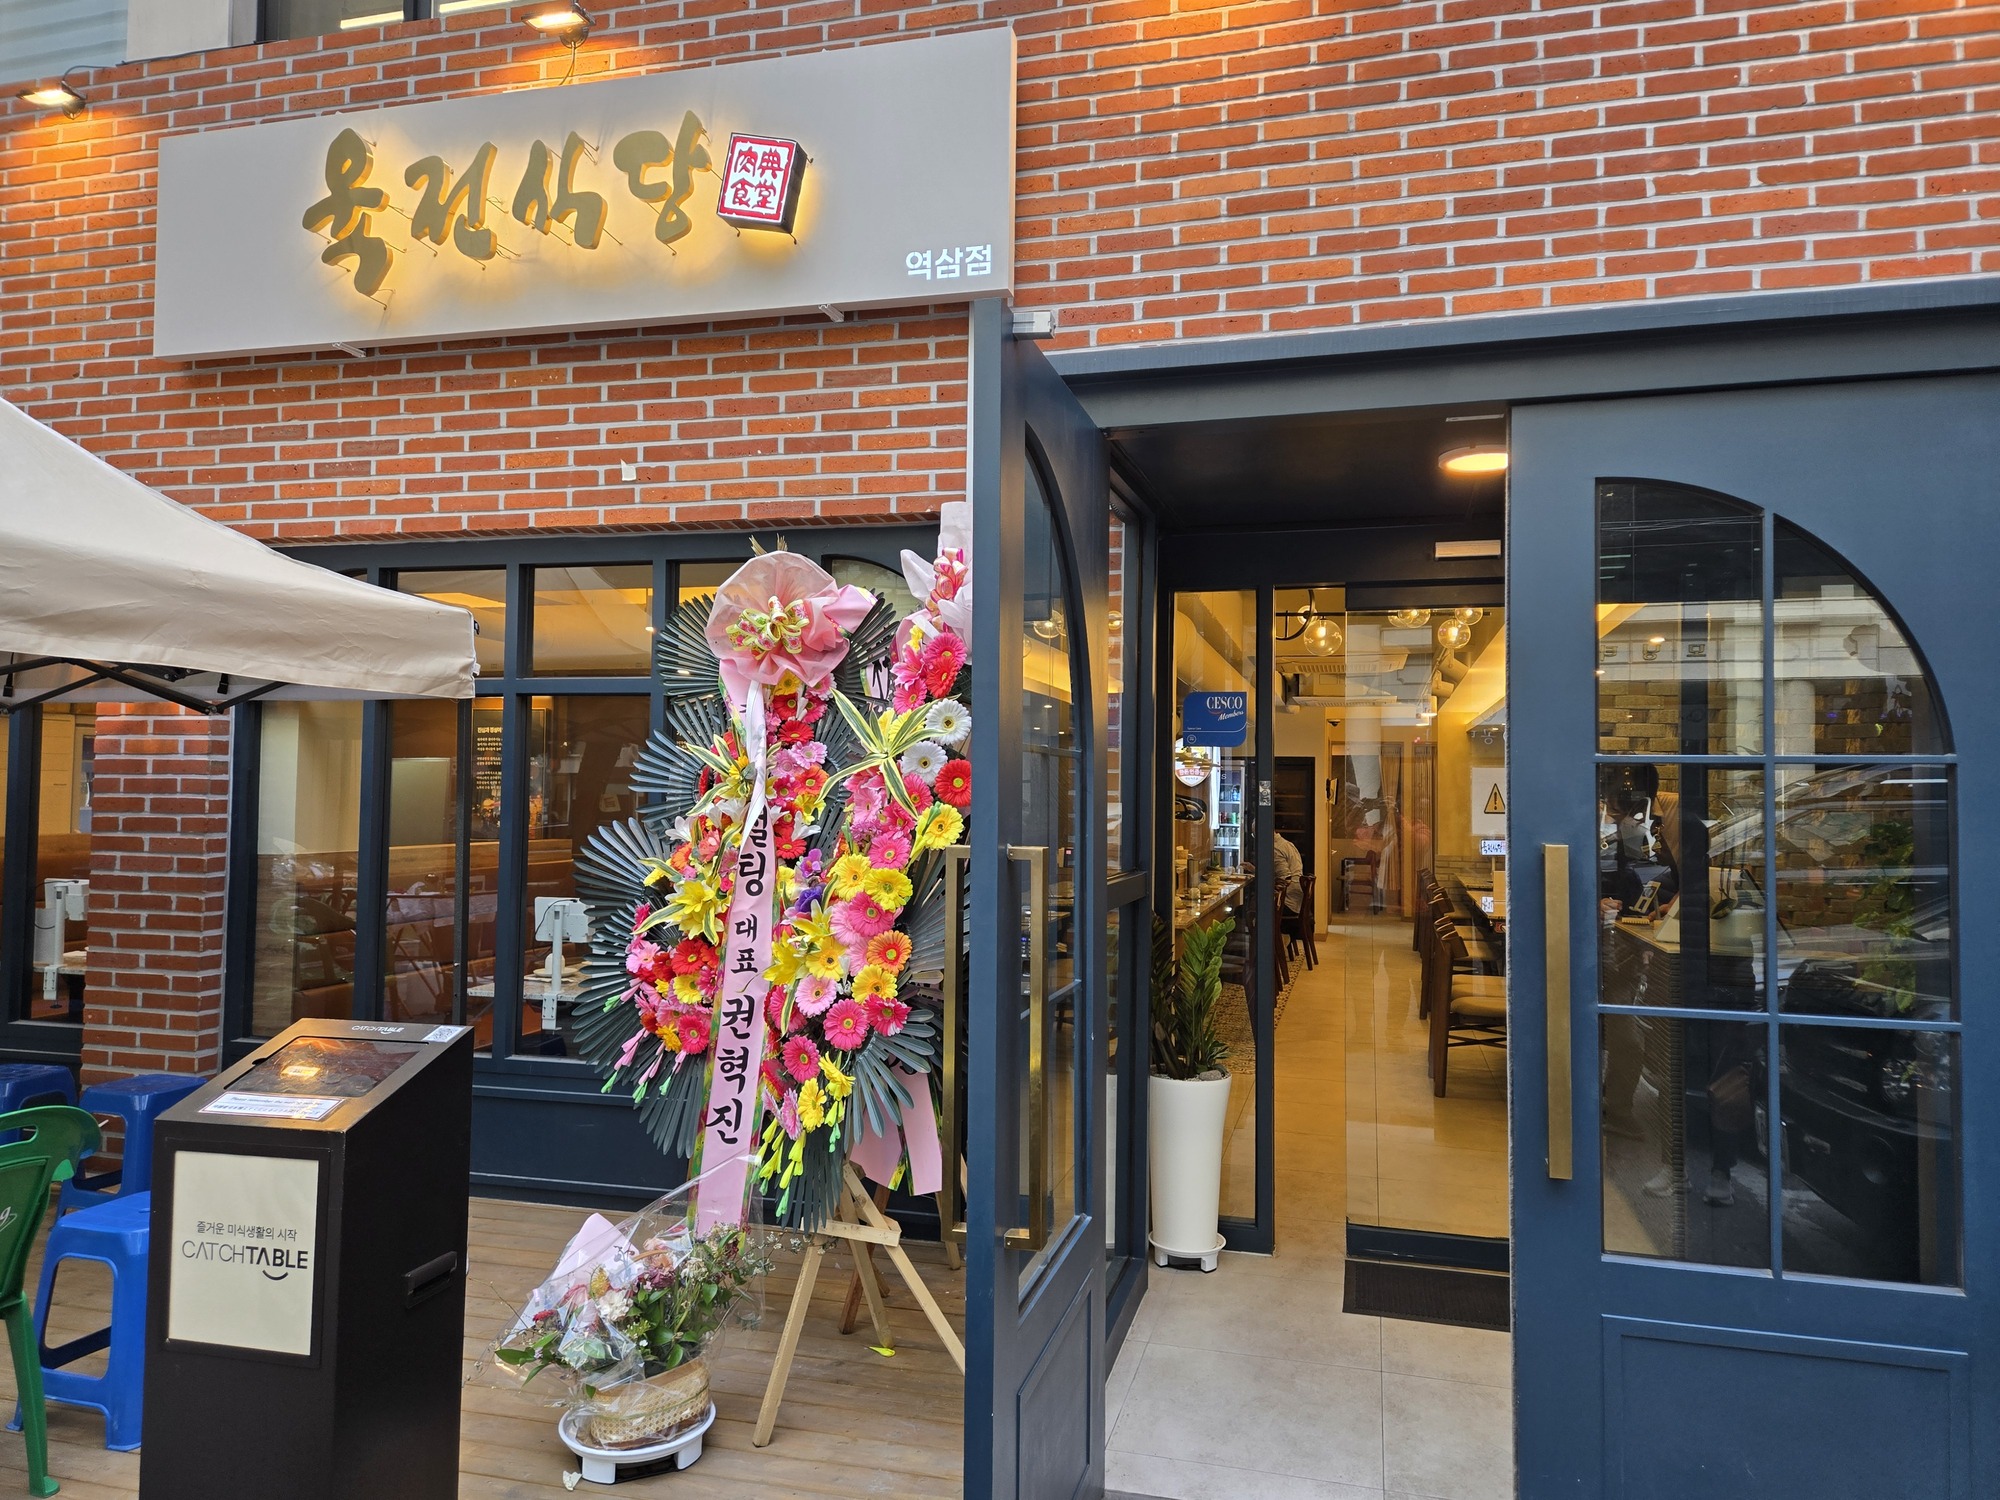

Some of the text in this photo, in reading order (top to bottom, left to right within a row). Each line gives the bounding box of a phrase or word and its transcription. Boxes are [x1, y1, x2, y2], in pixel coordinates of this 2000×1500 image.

[734, 146, 784, 179] 肉典
[730, 177, 777, 210] 食堂
[905, 244, 992, 280] 역삼점
[1206, 696, 1243, 710] CESCO
[1218, 710, 1244, 721] Members
[731, 914, 758, 974] 대표
[351, 1025, 405, 1034] CATCHTABLE
[705, 994, 755, 1145] 권혁진
[196, 1220, 298, 1242] 즐거운 미식생활의 시작
[181, 1240, 309, 1270] CATCHTABLE
